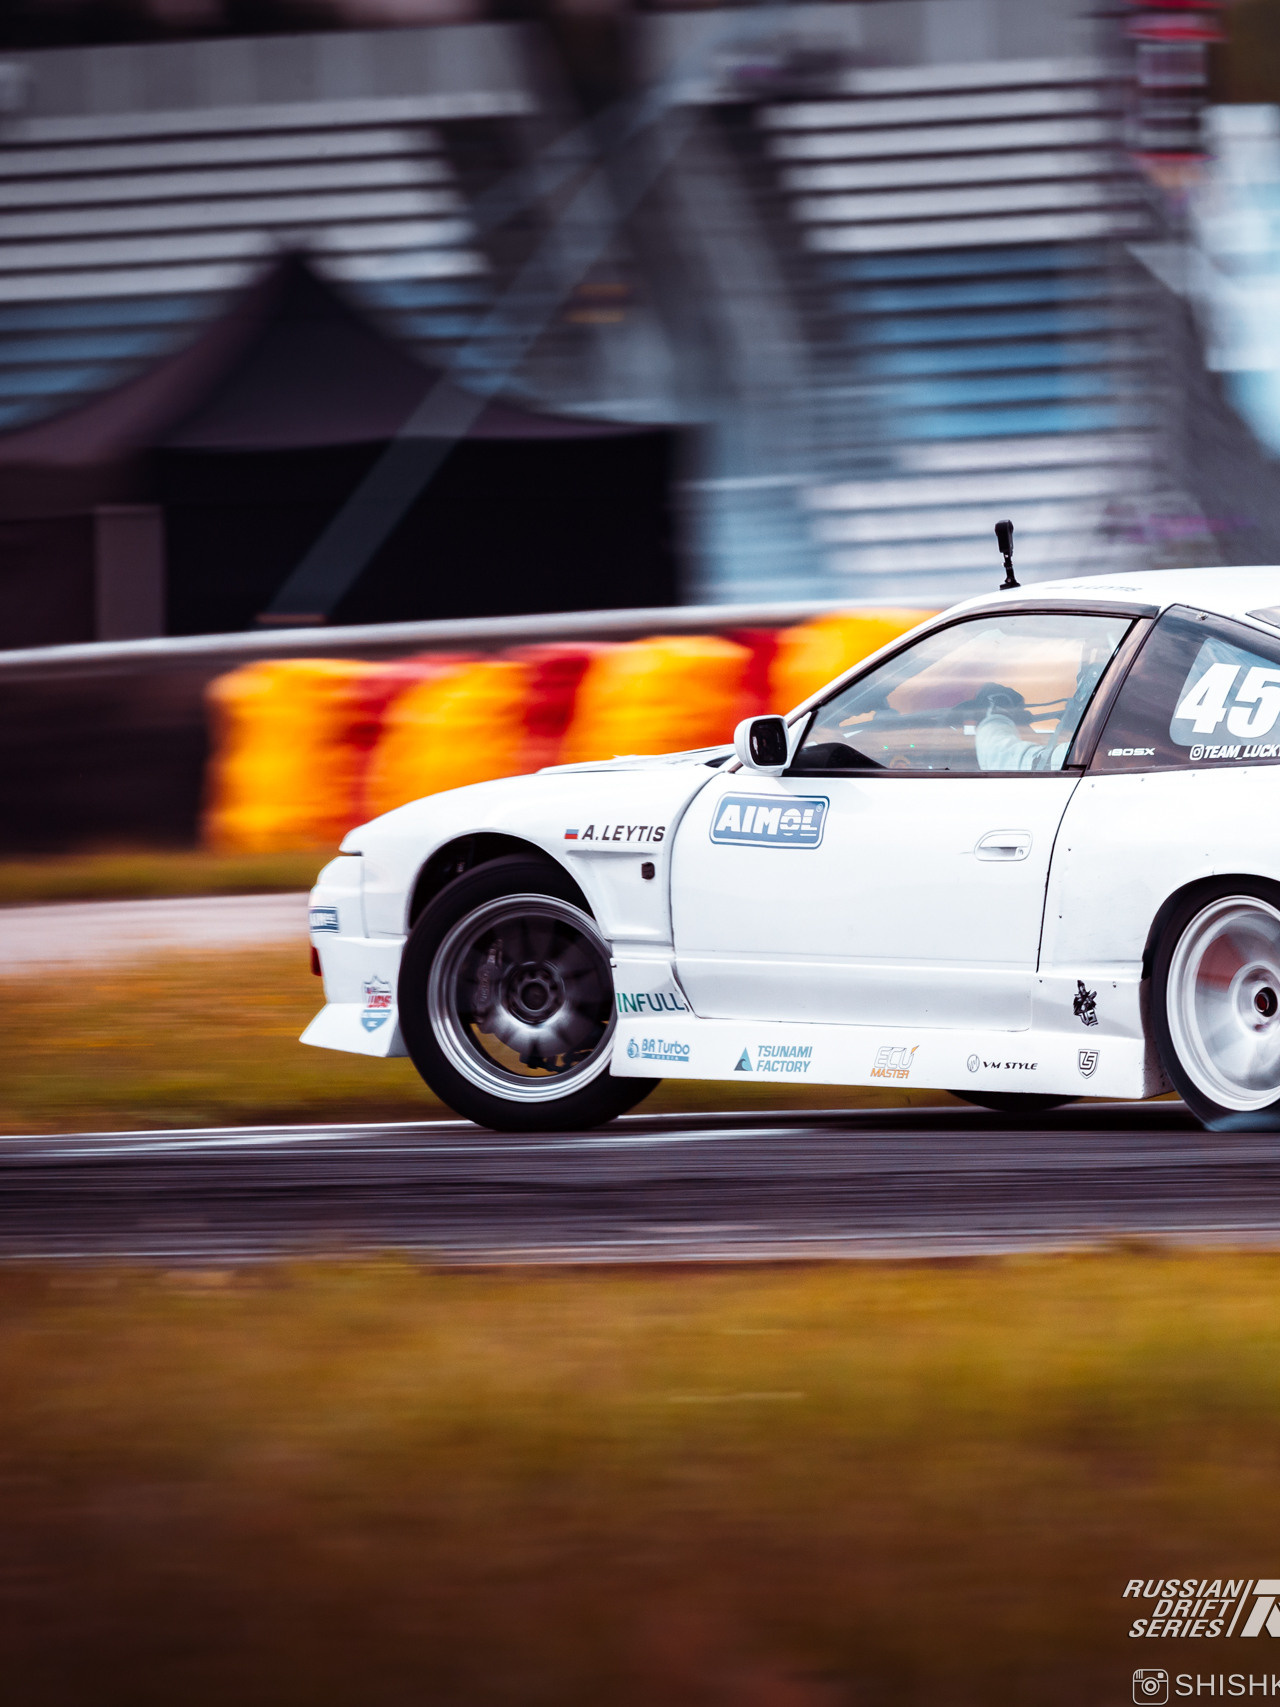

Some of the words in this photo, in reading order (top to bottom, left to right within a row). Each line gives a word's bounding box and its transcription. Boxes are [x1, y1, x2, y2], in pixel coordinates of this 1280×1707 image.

[715, 804, 818, 837] AIMOL
[581, 824, 666, 842] A.LEYTIS
[641, 1038, 655, 1054] BR
[658, 1039, 690, 1056] Turbo
[757, 1045, 813, 1058] TSUNAMI
[873, 1045, 918, 1070] ECU
[756, 1060, 811, 1073] FACTORY
[983, 1061, 1001, 1069] VM
[1004, 1061, 1038, 1070] STYLE
[870, 1068, 910, 1079] MASTER
